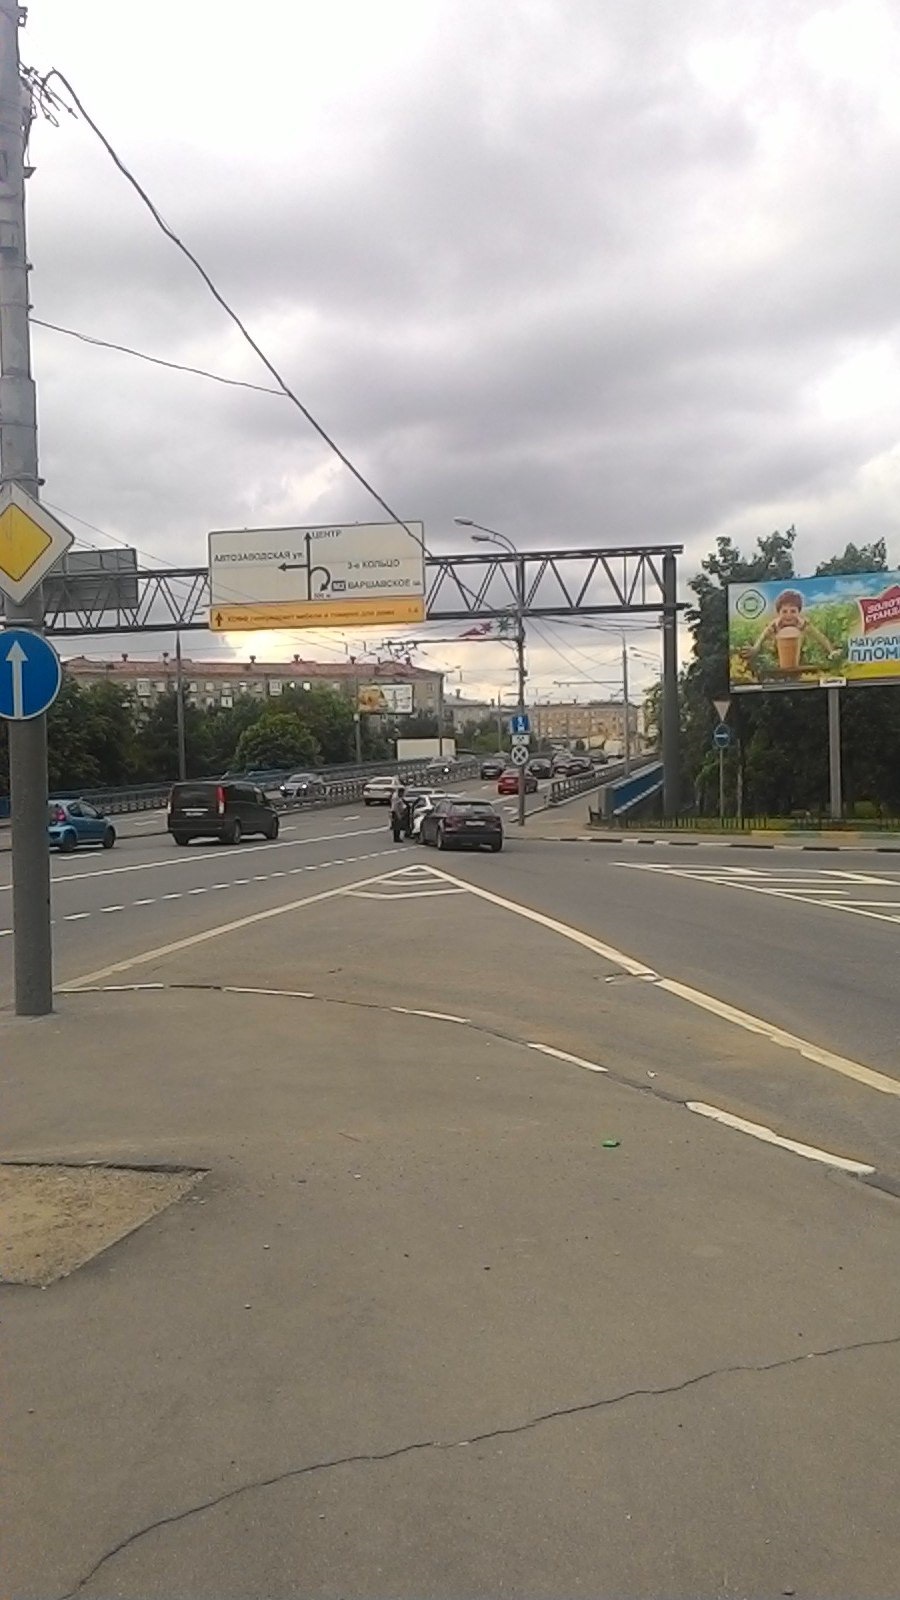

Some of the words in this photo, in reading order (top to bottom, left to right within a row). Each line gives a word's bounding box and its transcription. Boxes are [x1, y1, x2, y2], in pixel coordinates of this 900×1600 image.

[312, 530, 342, 539] ЦЕНТР
[214, 550, 290, 562] АВТОЗАВОДСКАЯ
[362, 559, 400, 569] КОЛЬЦО
[348, 579, 411, 589] ВАРШАВСКОЕ
[851, 646, 898, 661] ПЛОМ
